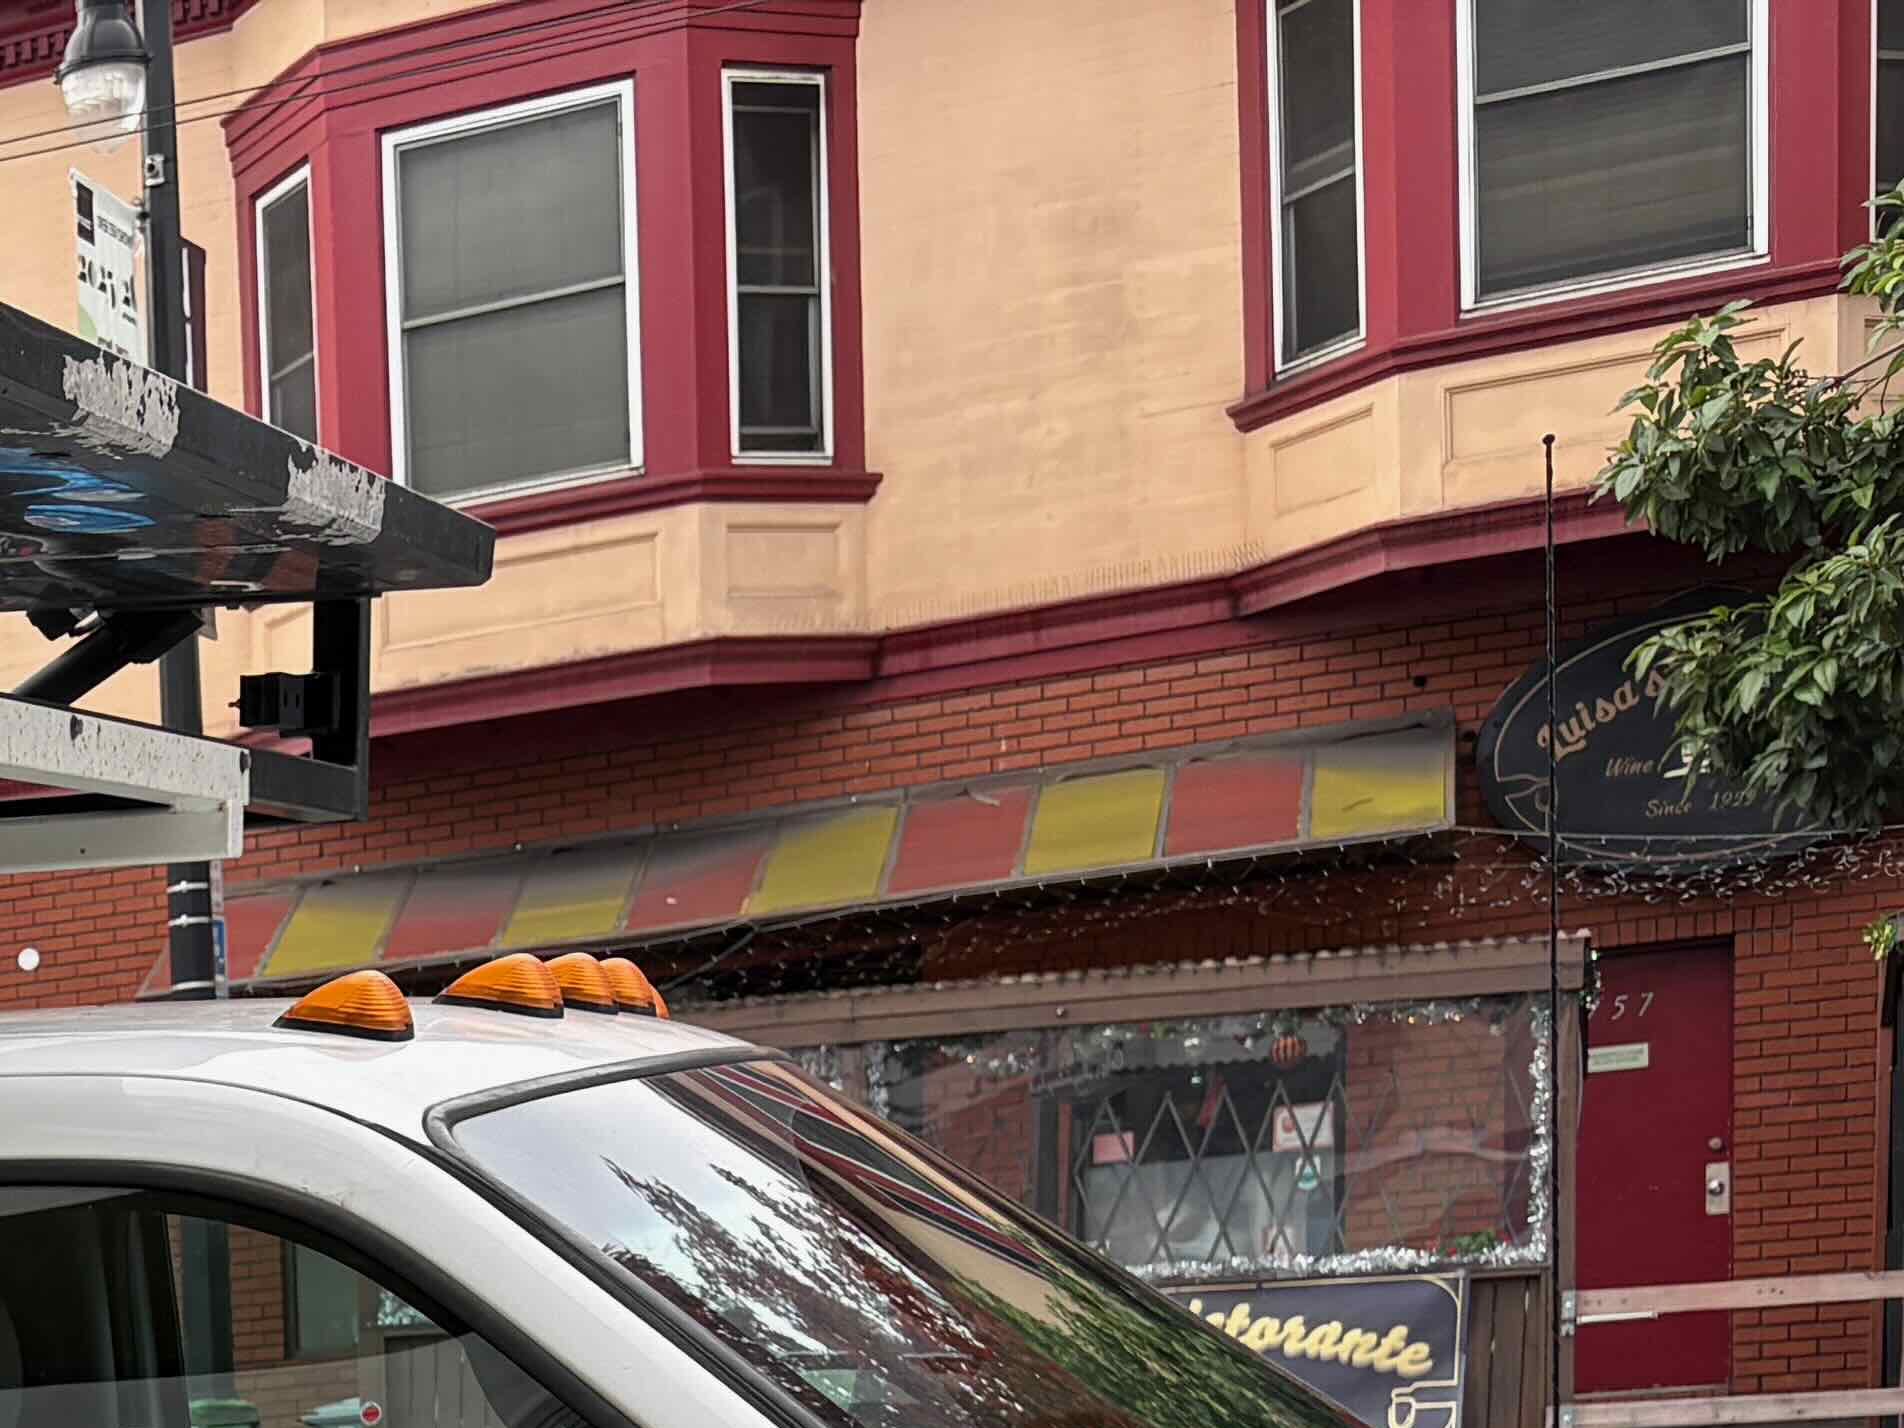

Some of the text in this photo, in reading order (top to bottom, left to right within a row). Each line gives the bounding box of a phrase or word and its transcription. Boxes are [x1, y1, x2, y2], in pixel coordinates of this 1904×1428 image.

[1537, 669, 1667, 762] Luisas
[1605, 755, 1653, 777] Wine
[1645, 799, 1692, 818] Since
[1587, 991, 1654, 1020] 57
